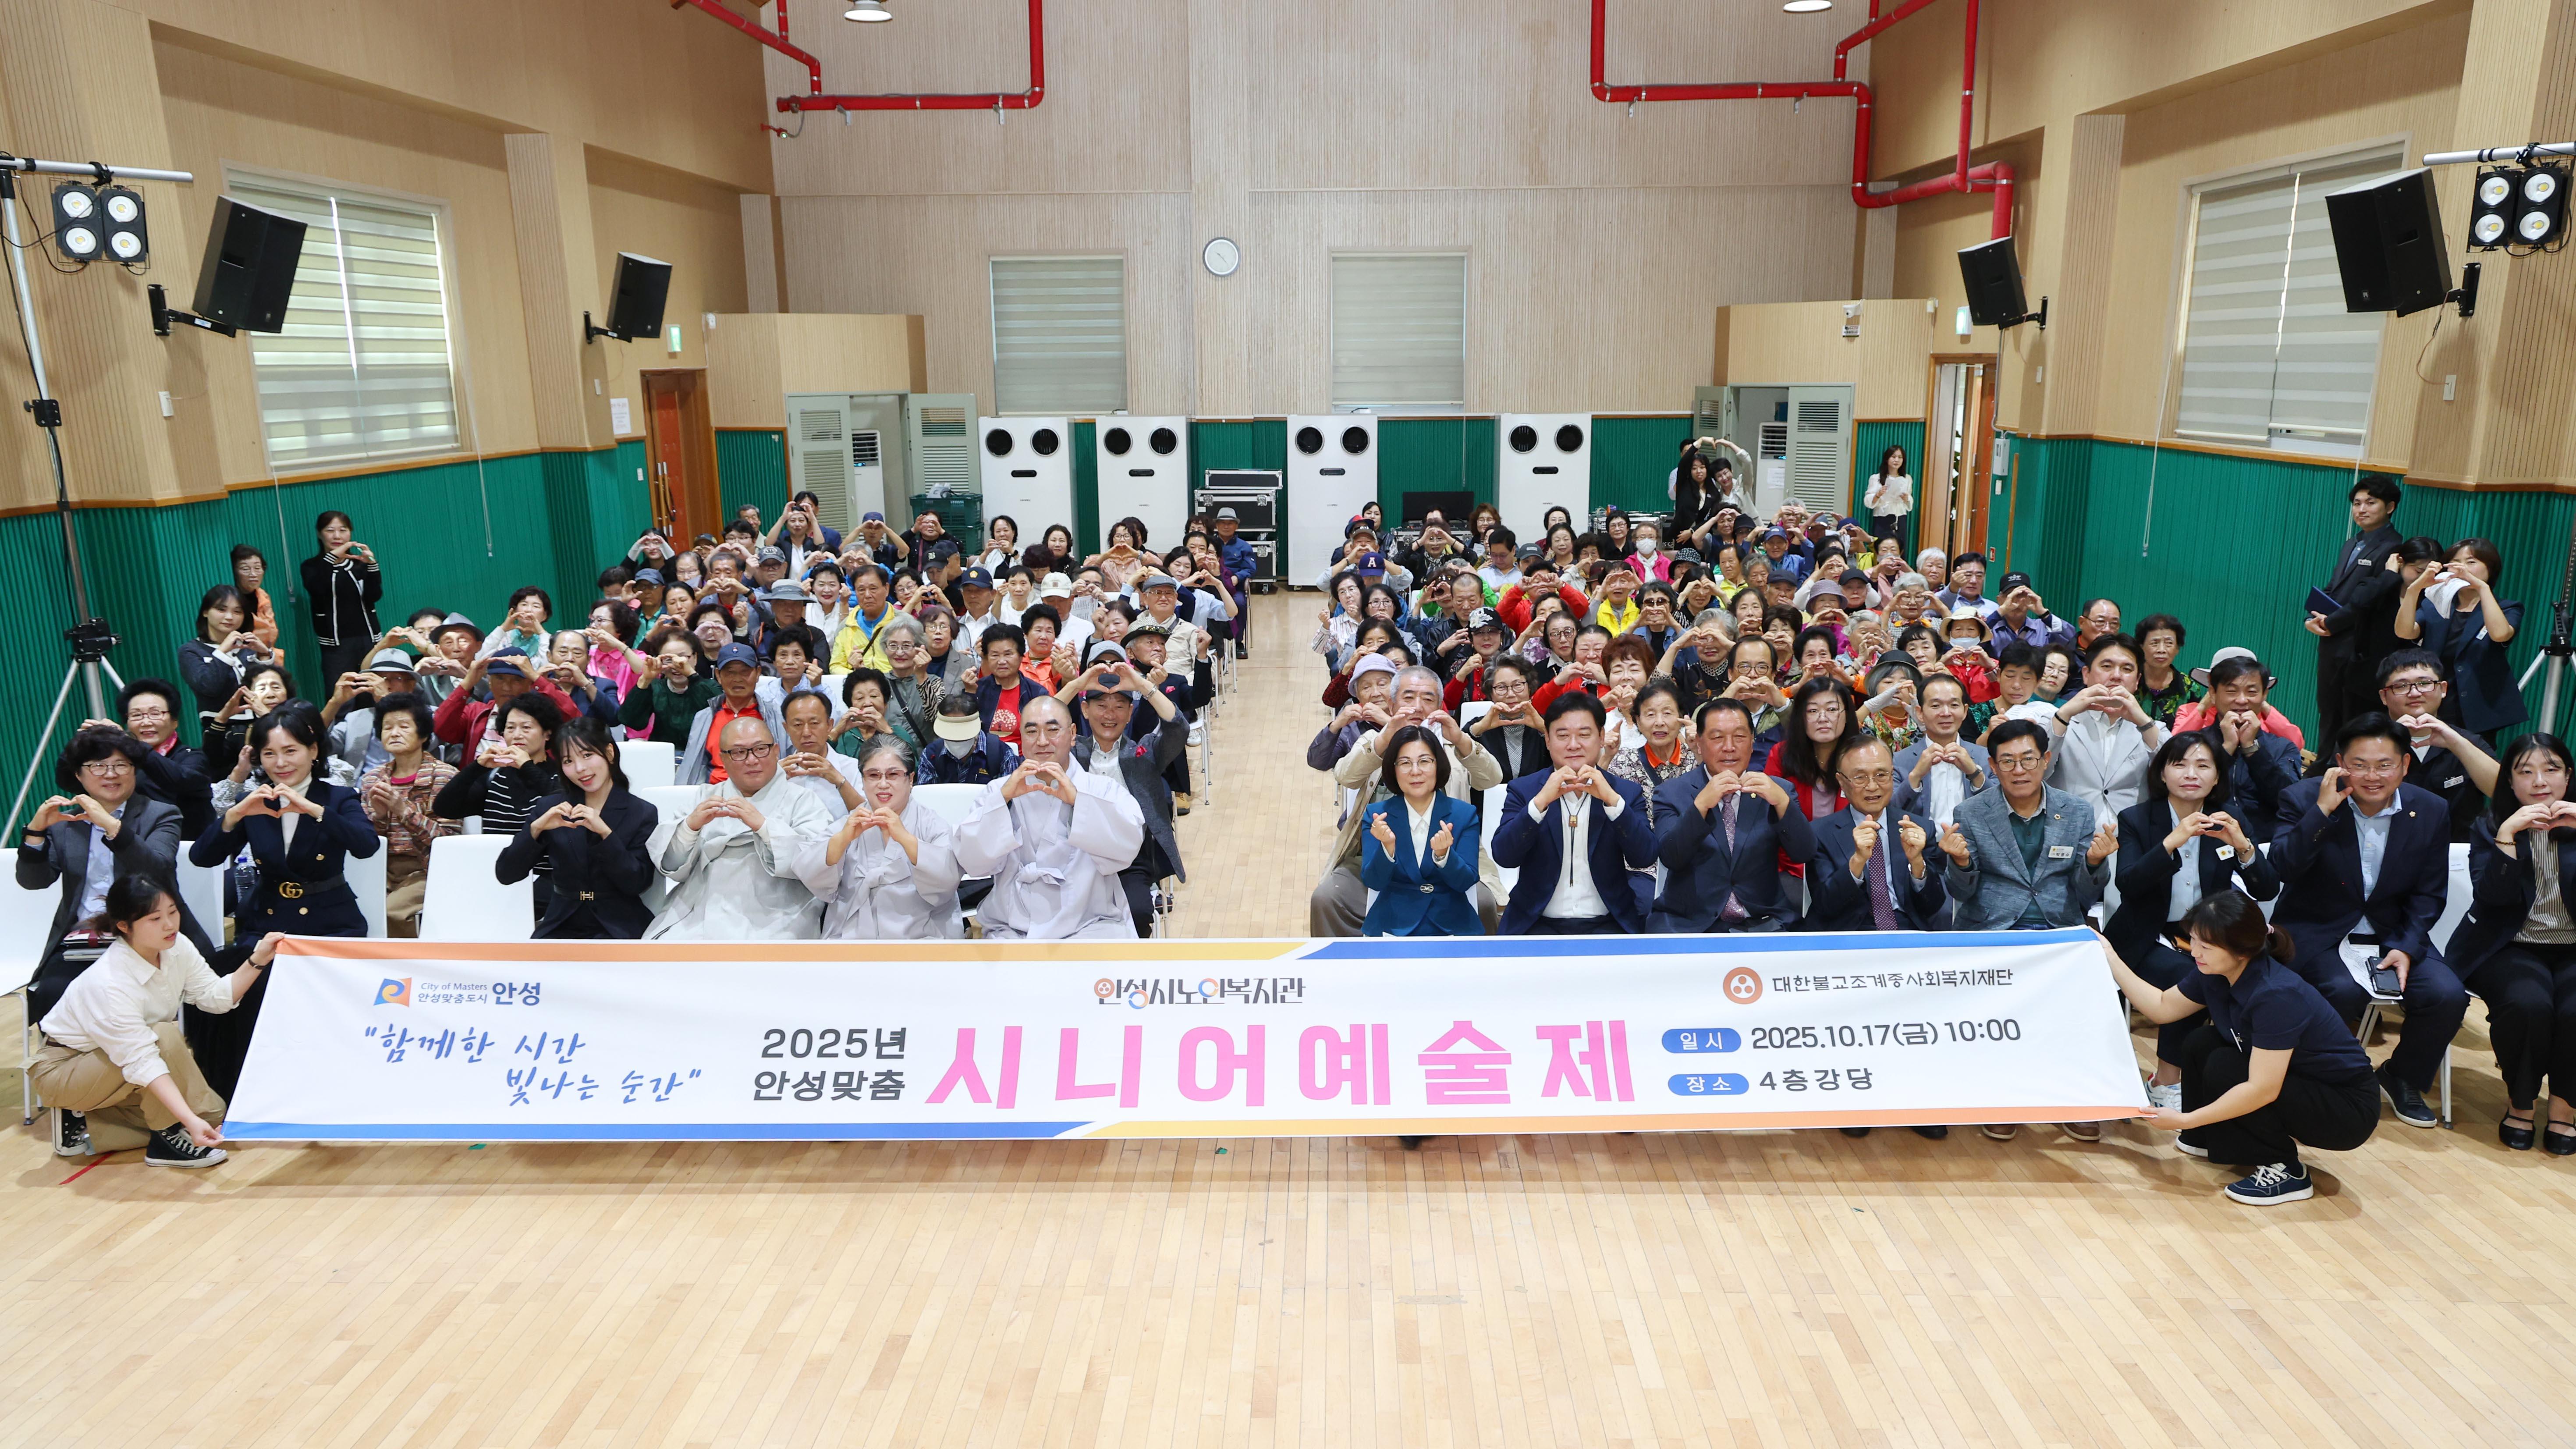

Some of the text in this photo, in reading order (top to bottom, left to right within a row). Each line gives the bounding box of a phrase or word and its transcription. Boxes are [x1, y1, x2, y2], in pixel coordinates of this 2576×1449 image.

[1367, 557, 1377, 567] A
[421, 983, 439, 991] City
[453, 983, 488, 991] Masters
[492, 982, 541, 1006] 안성
[1094, 978, 1306, 1009] 안성시노인복지관
[1772, 968, 2014, 993] 대한불교조계종사회복지재단
[418, 993, 488, 1004] 안성맞춤도시
[514, 1031, 586, 1064] 시간
[761, 1027, 907, 1060] 2025년
[1751, 1021, 1938, 1049] 2025.10.17(금)
[1944, 1019, 2021, 1042] 10:00
[925, 1020, 1635, 1109] 시니어예술제
[507, 1066, 600, 1107] 빛나는
[753, 1069, 906, 1102] 안성맞춤
